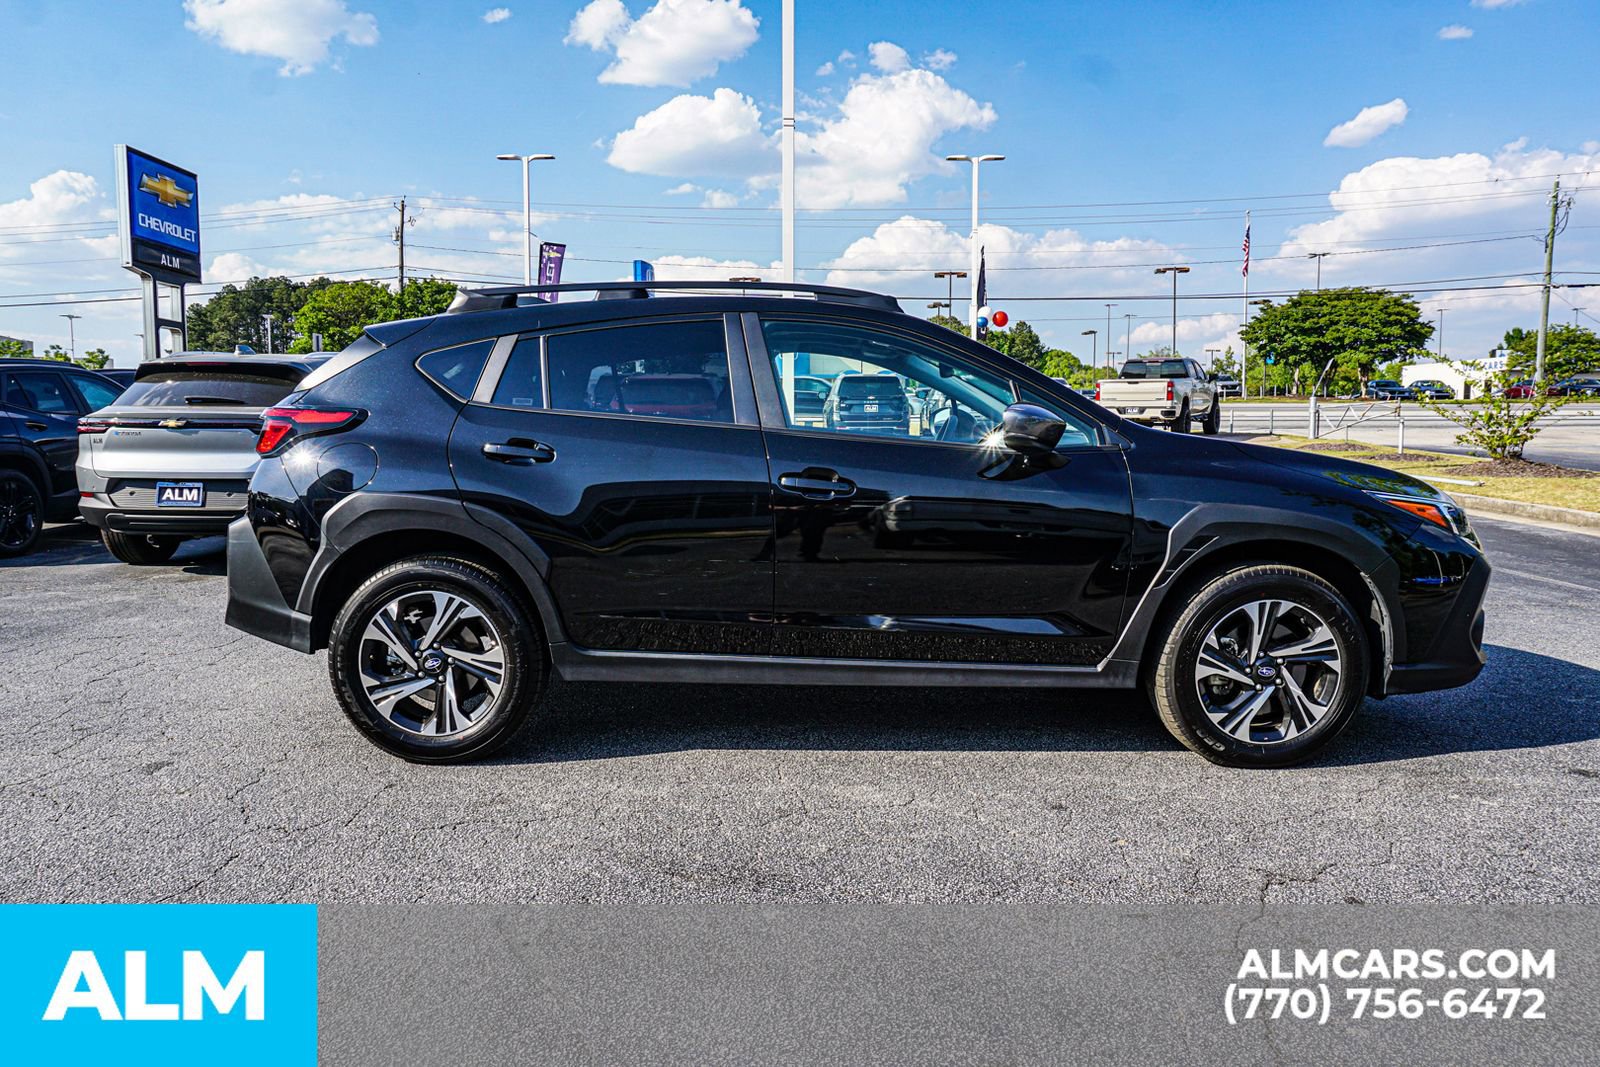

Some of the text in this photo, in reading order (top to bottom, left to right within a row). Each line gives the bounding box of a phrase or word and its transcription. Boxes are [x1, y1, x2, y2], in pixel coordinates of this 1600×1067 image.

[138, 213, 196, 242] CHEVROLET
[161, 253, 180, 269] ALM
[1484, 360, 1504, 370] CARS
[161, 488, 198, 501] ALM
